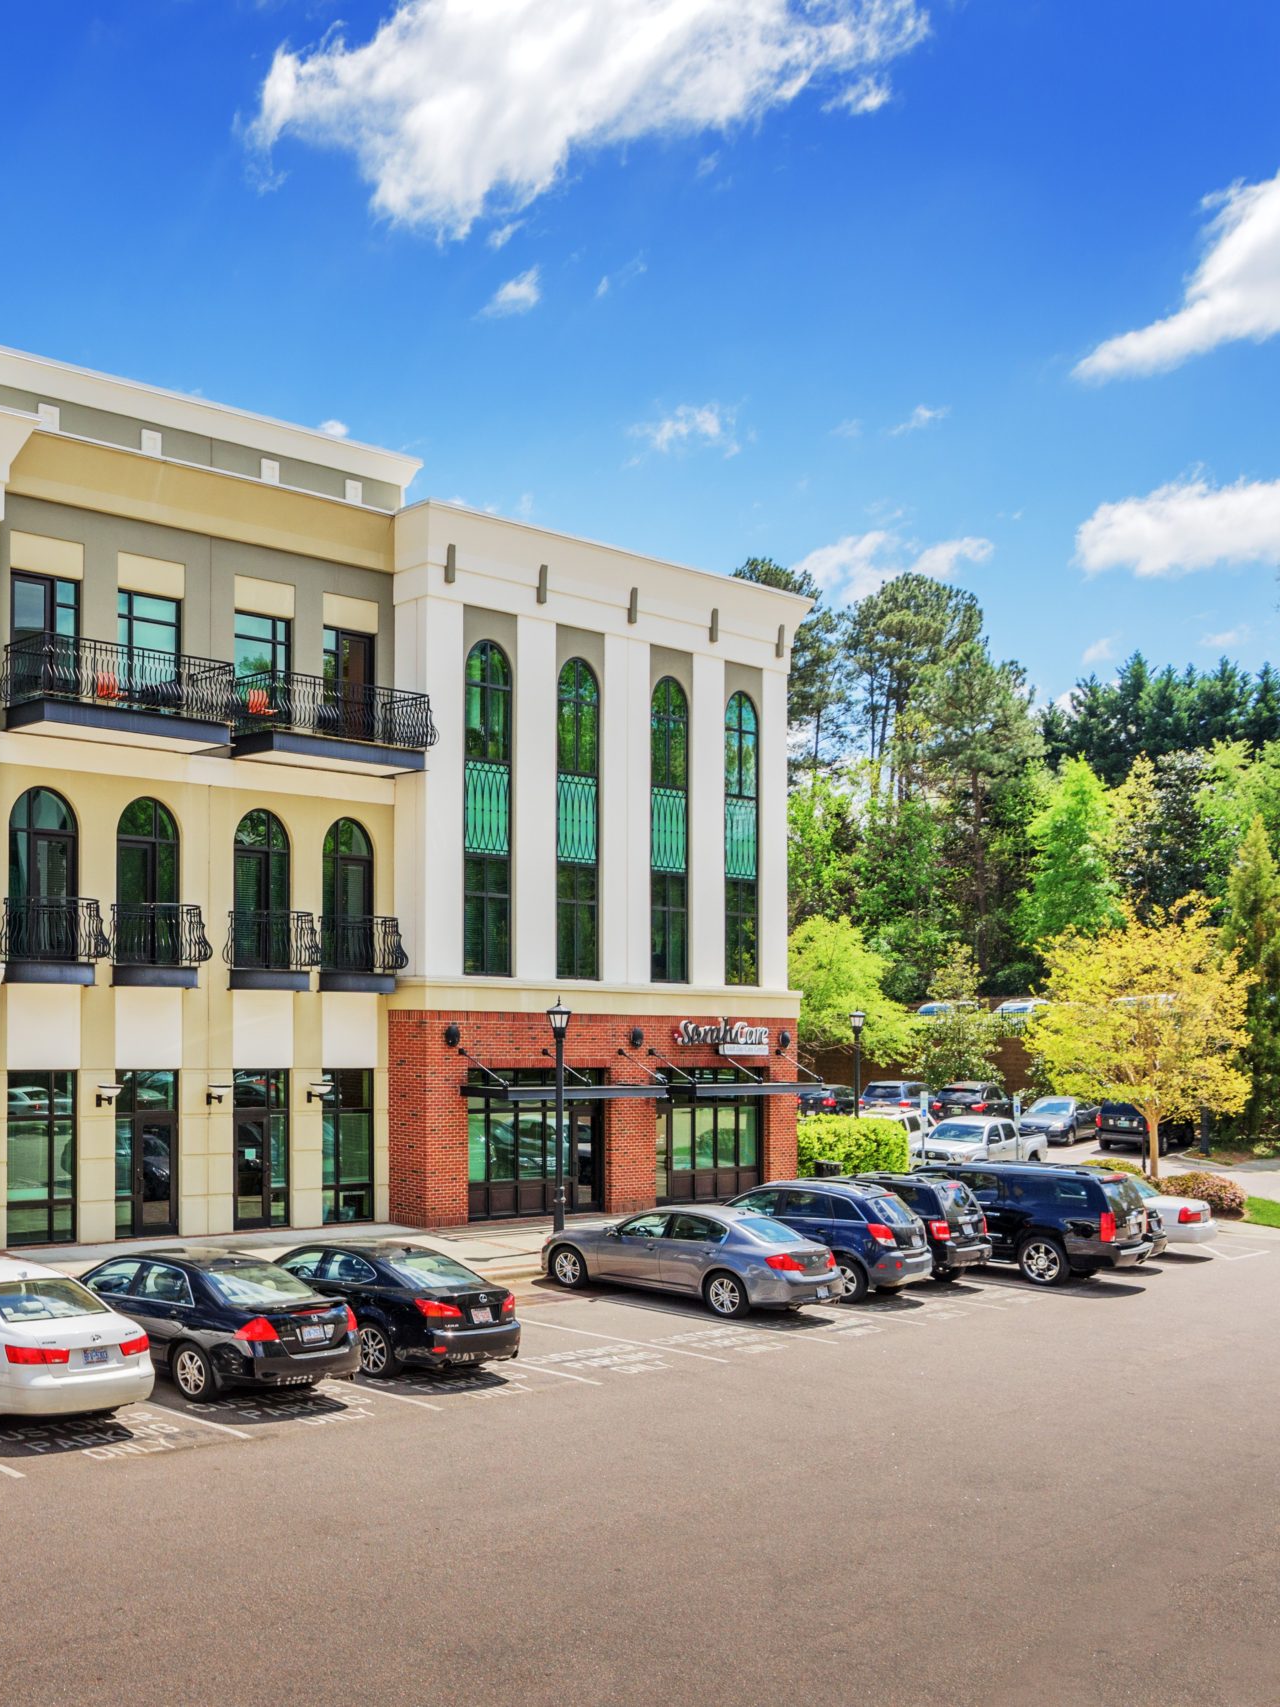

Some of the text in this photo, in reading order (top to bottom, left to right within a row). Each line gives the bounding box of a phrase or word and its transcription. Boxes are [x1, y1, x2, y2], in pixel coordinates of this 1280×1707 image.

[238, 1395, 371, 1420] PARKING
[294, 1407, 376, 1426] ONLY
[24, 1423, 180, 1453] PARKING
[81, 1437, 176, 1460] ONLY
